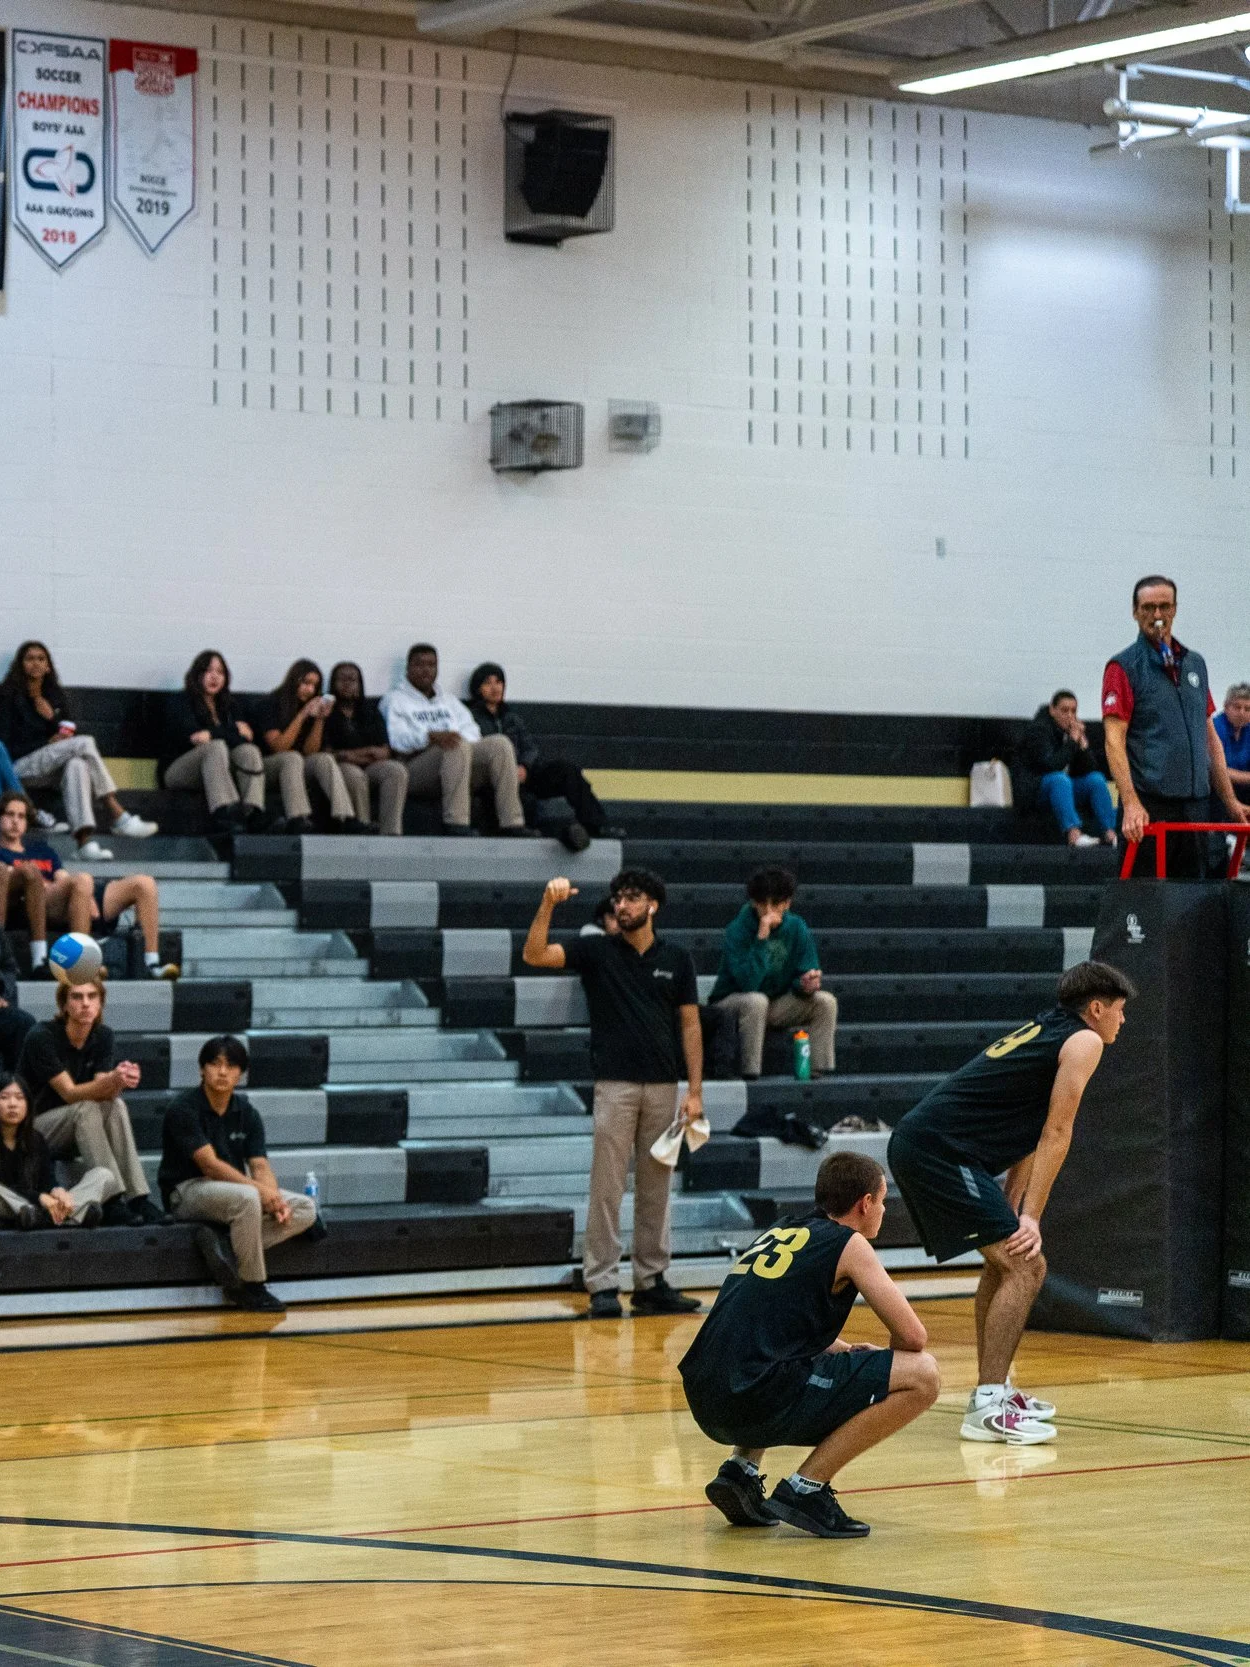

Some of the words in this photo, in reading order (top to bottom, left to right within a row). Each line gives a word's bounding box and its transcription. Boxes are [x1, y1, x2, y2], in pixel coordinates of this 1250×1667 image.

[35, 66, 82, 84] SOCCER
[18, 90, 100, 117] CHAMPIONS
[64, 122, 85, 135] AAA
[136, 198, 170, 216] 2019
[42, 228, 77, 244] 2018
[731, 1227, 810, 1279] 23
